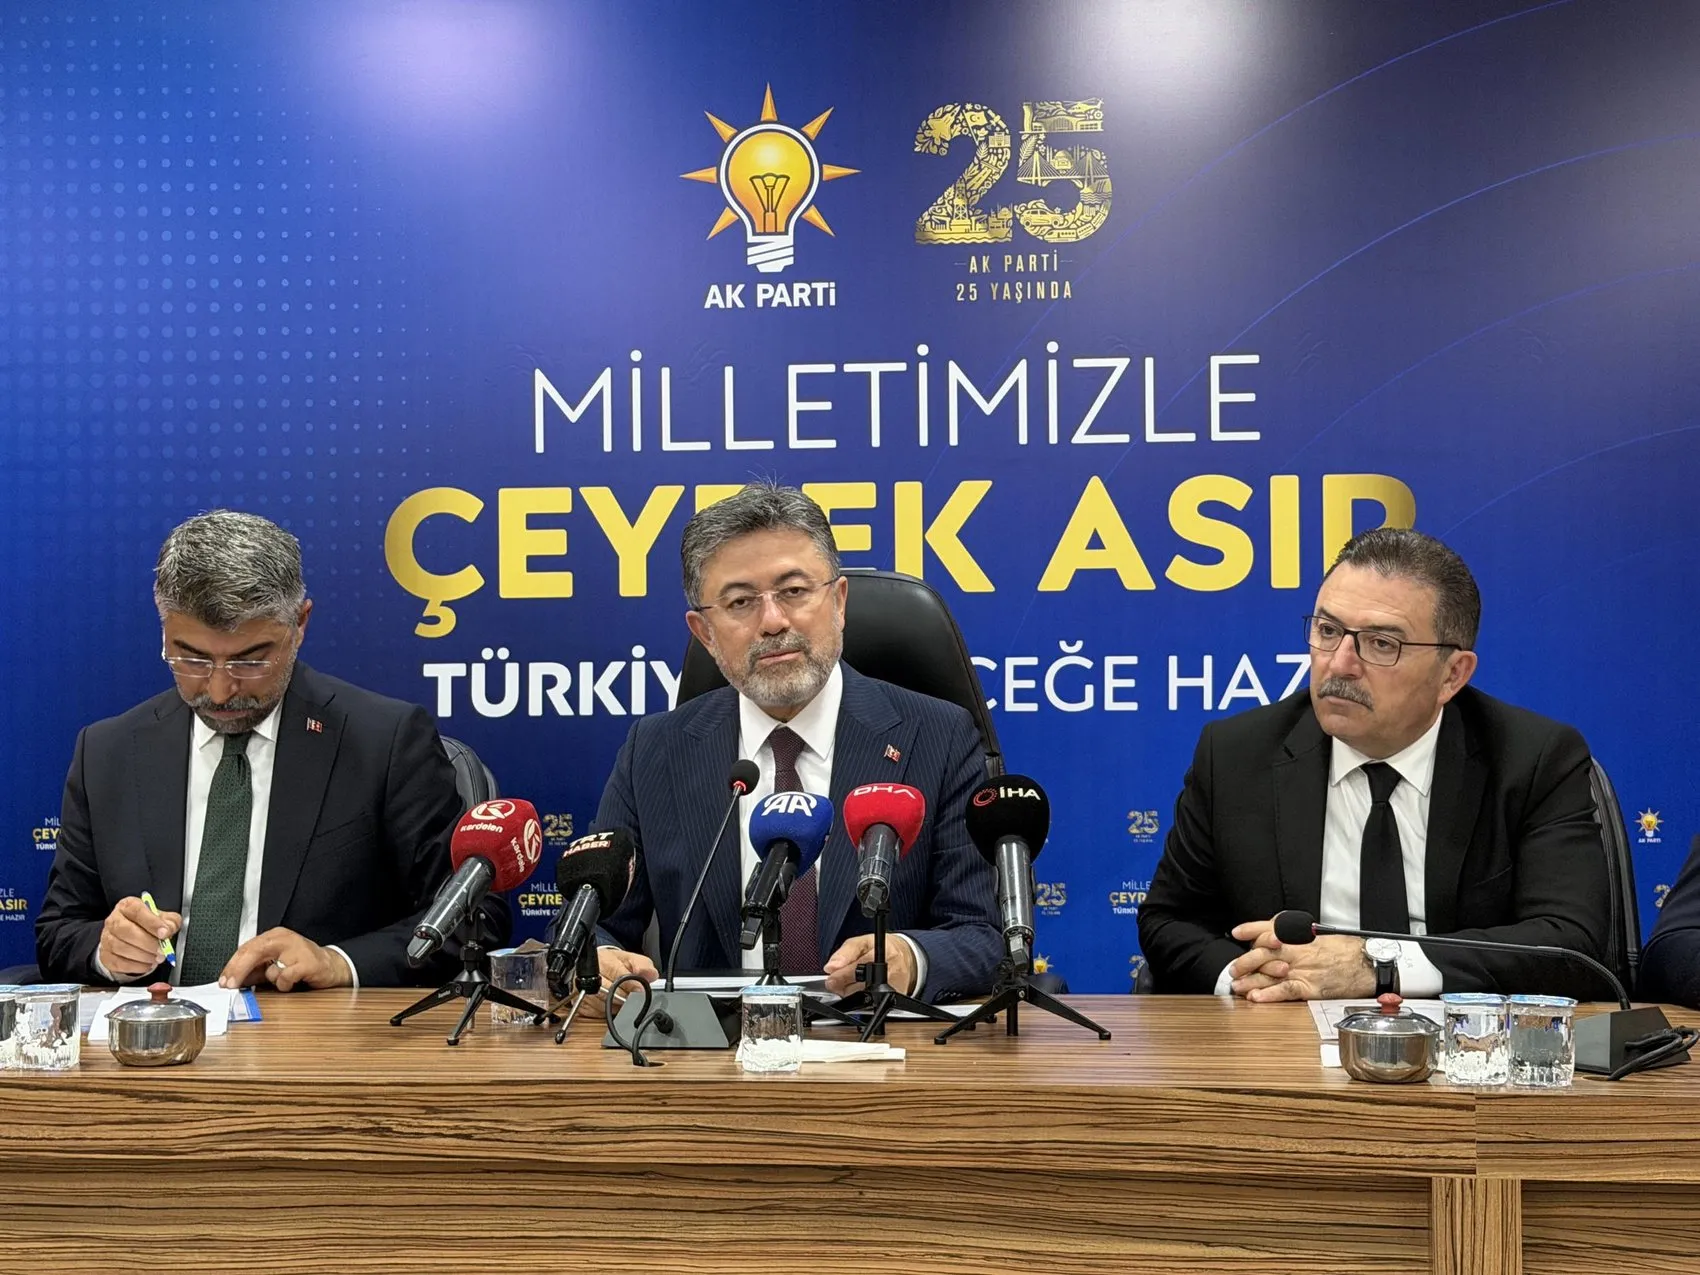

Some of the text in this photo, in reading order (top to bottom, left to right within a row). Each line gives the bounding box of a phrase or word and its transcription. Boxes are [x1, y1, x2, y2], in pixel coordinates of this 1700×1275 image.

[914, 97, 1113, 244] 25
[969, 249, 1058, 273] AK PARTİ
[704, 284, 745, 309] AK
[956, 281, 1072, 304] 25 YAŞINDA
[534, 341, 1261, 454] MİLLETİMİZLE
[384, 480, 996, 638] ÇEYEK
[423, 645, 683, 718] TÜRKİY
[853, 786, 916, 799] DHA
[1000, 787, 1041, 800] İHA
[761, 795, 813, 817] AA
[543, 814, 573, 837] 25
[1127, 811, 1159, 834] 25
[1037, 882, 1067, 906] 25
